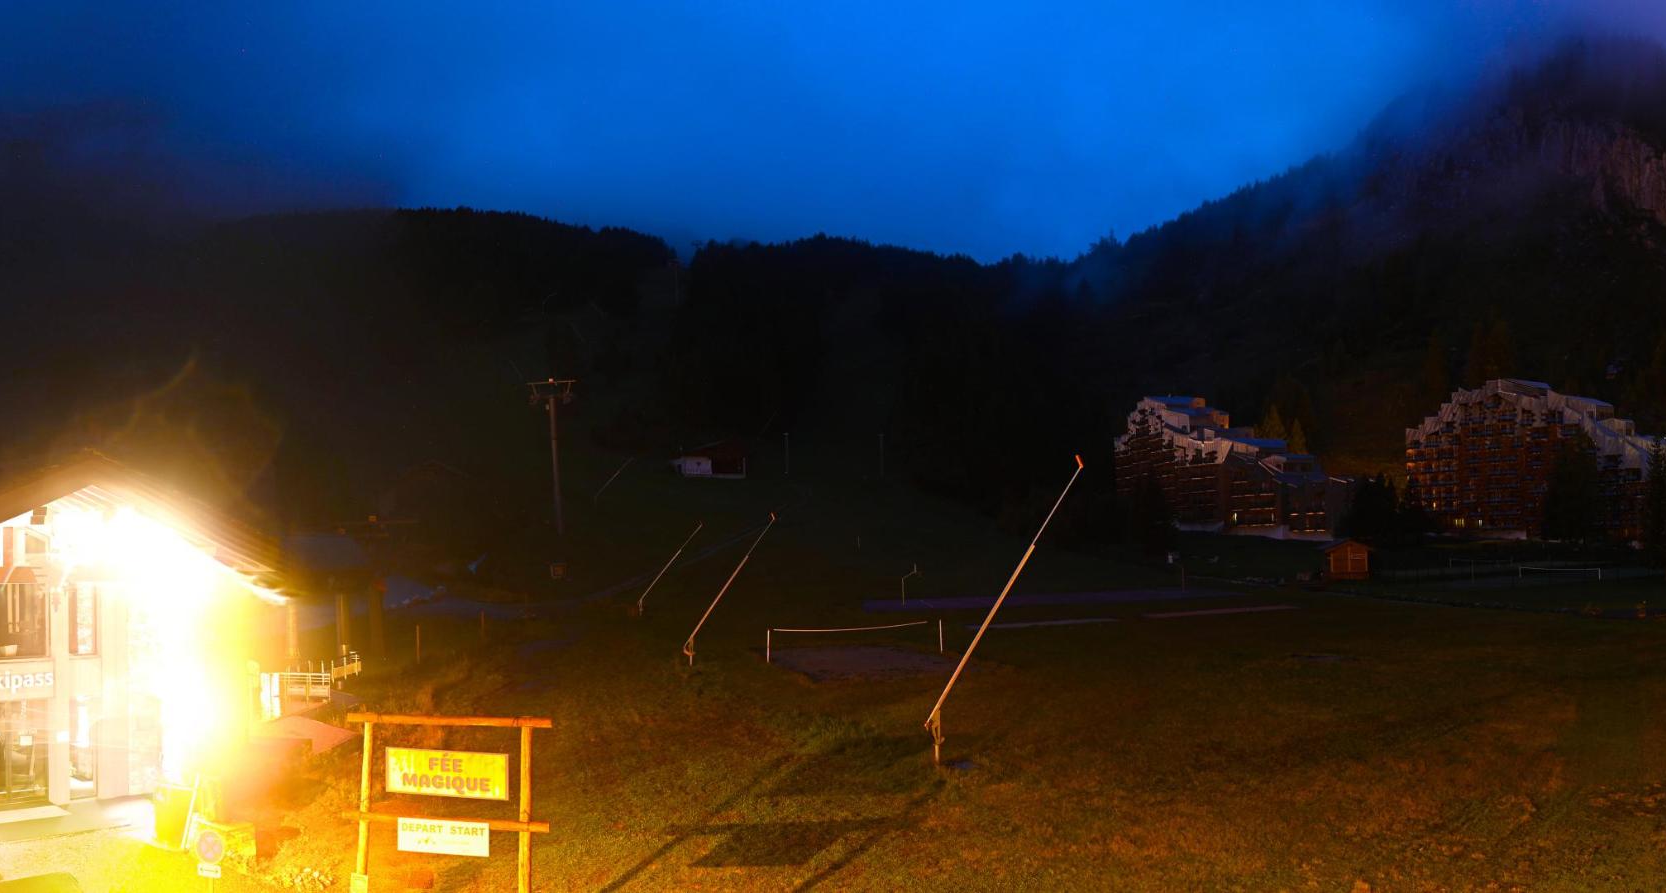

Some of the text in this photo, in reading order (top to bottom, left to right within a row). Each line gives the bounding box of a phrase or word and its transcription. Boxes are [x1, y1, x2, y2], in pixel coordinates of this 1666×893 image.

[428, 753, 463, 773] FÉE
[402, 772, 491, 795] MAGIQUE
[450, 826, 486, 836] START
